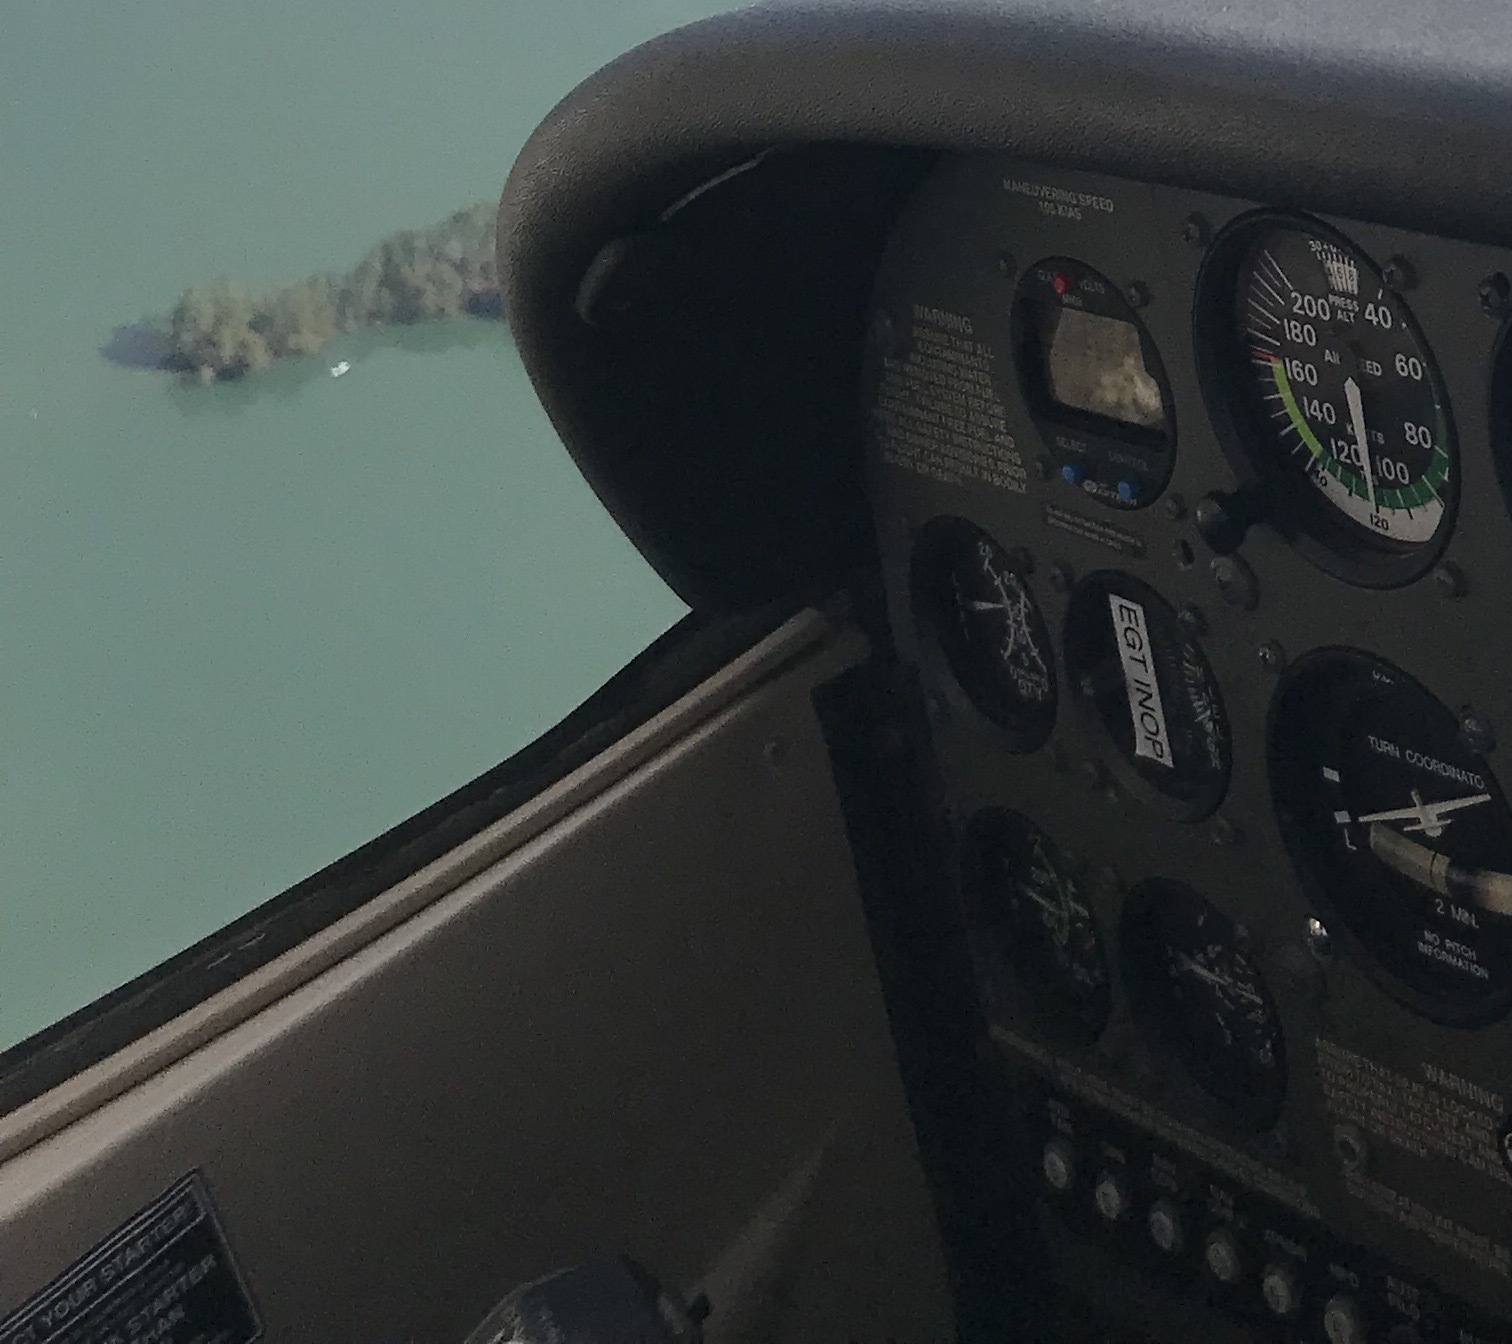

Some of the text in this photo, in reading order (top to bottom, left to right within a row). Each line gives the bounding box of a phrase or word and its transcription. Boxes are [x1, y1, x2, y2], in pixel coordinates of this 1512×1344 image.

[1290, 290, 1332, 322] 200
[1336, 308, 1356, 326] ALT
[1364, 301, 1394, 330] 40
[1282, 318, 1317, 348] 180
[1284, 357, 1319, 387] 160
[1394, 353, 1423, 382] 60
[1303, 396, 1337, 425] 140
[1403, 421, 1434, 449] 80
[1330, 437, 1365, 467] 120
[1374, 455, 1411, 486] 100
[1370, 512, 1390, 531] 120
[1118, 603, 1165, 760] EGT INOP
[1367, 734, 1488, 790] TURN COORDINATO
[1343, 827, 1358, 852] L
[1434, 898, 1446, 915] 2
[41, 1277, 99, 1328] YOUR
[99, 1204, 185, 1284] STARTER
